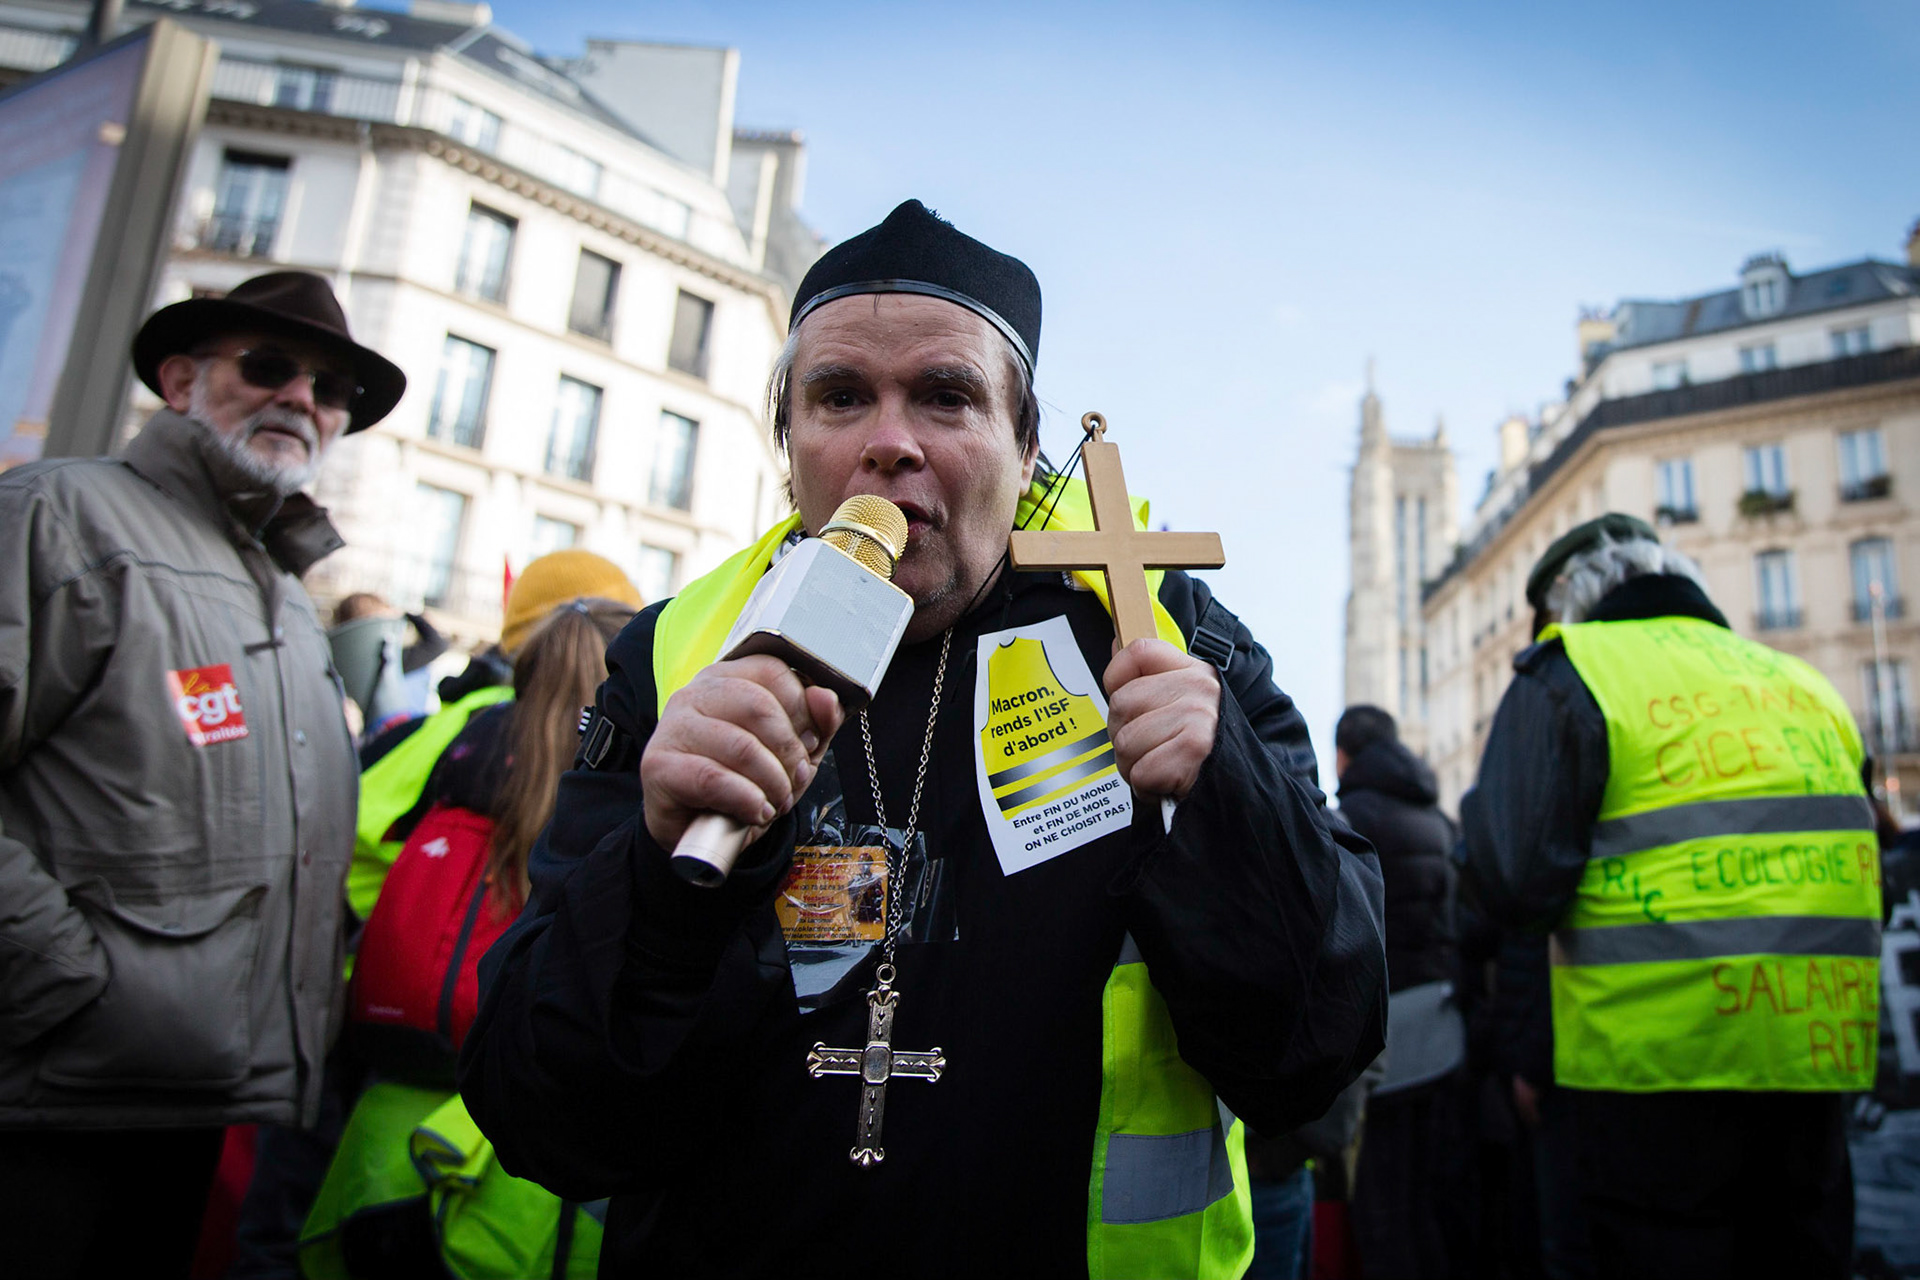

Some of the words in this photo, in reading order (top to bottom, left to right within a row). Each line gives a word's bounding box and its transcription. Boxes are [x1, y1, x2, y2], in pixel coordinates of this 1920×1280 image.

[179, 683, 242, 725] cgt
[990, 715, 1032, 738] rends
[1033, 697, 1070, 722] l'ISF
[991, 685, 1055, 715] Macron,
[1003, 721, 1068, 757] d'abord
[1013, 813, 1042, 829] Entre
[1043, 804, 1062, 818] FIN
[1063, 797, 1079, 809] DU
[1080, 779, 1120, 802] MONDE
[1033, 824, 1045, 835] et
[1046, 816, 1065, 830] FIN
[1066, 809, 1082, 822] DE
[1083, 796, 1111, 814] MOIS
[1025, 839, 1042, 852] ON
[1043, 832, 1060, 845] NE
[1060, 813, 1103, 837] CHOISIT
[1104, 804, 1126, 819] PAS
[1691, 844, 1851, 891] ECOLOGIE
